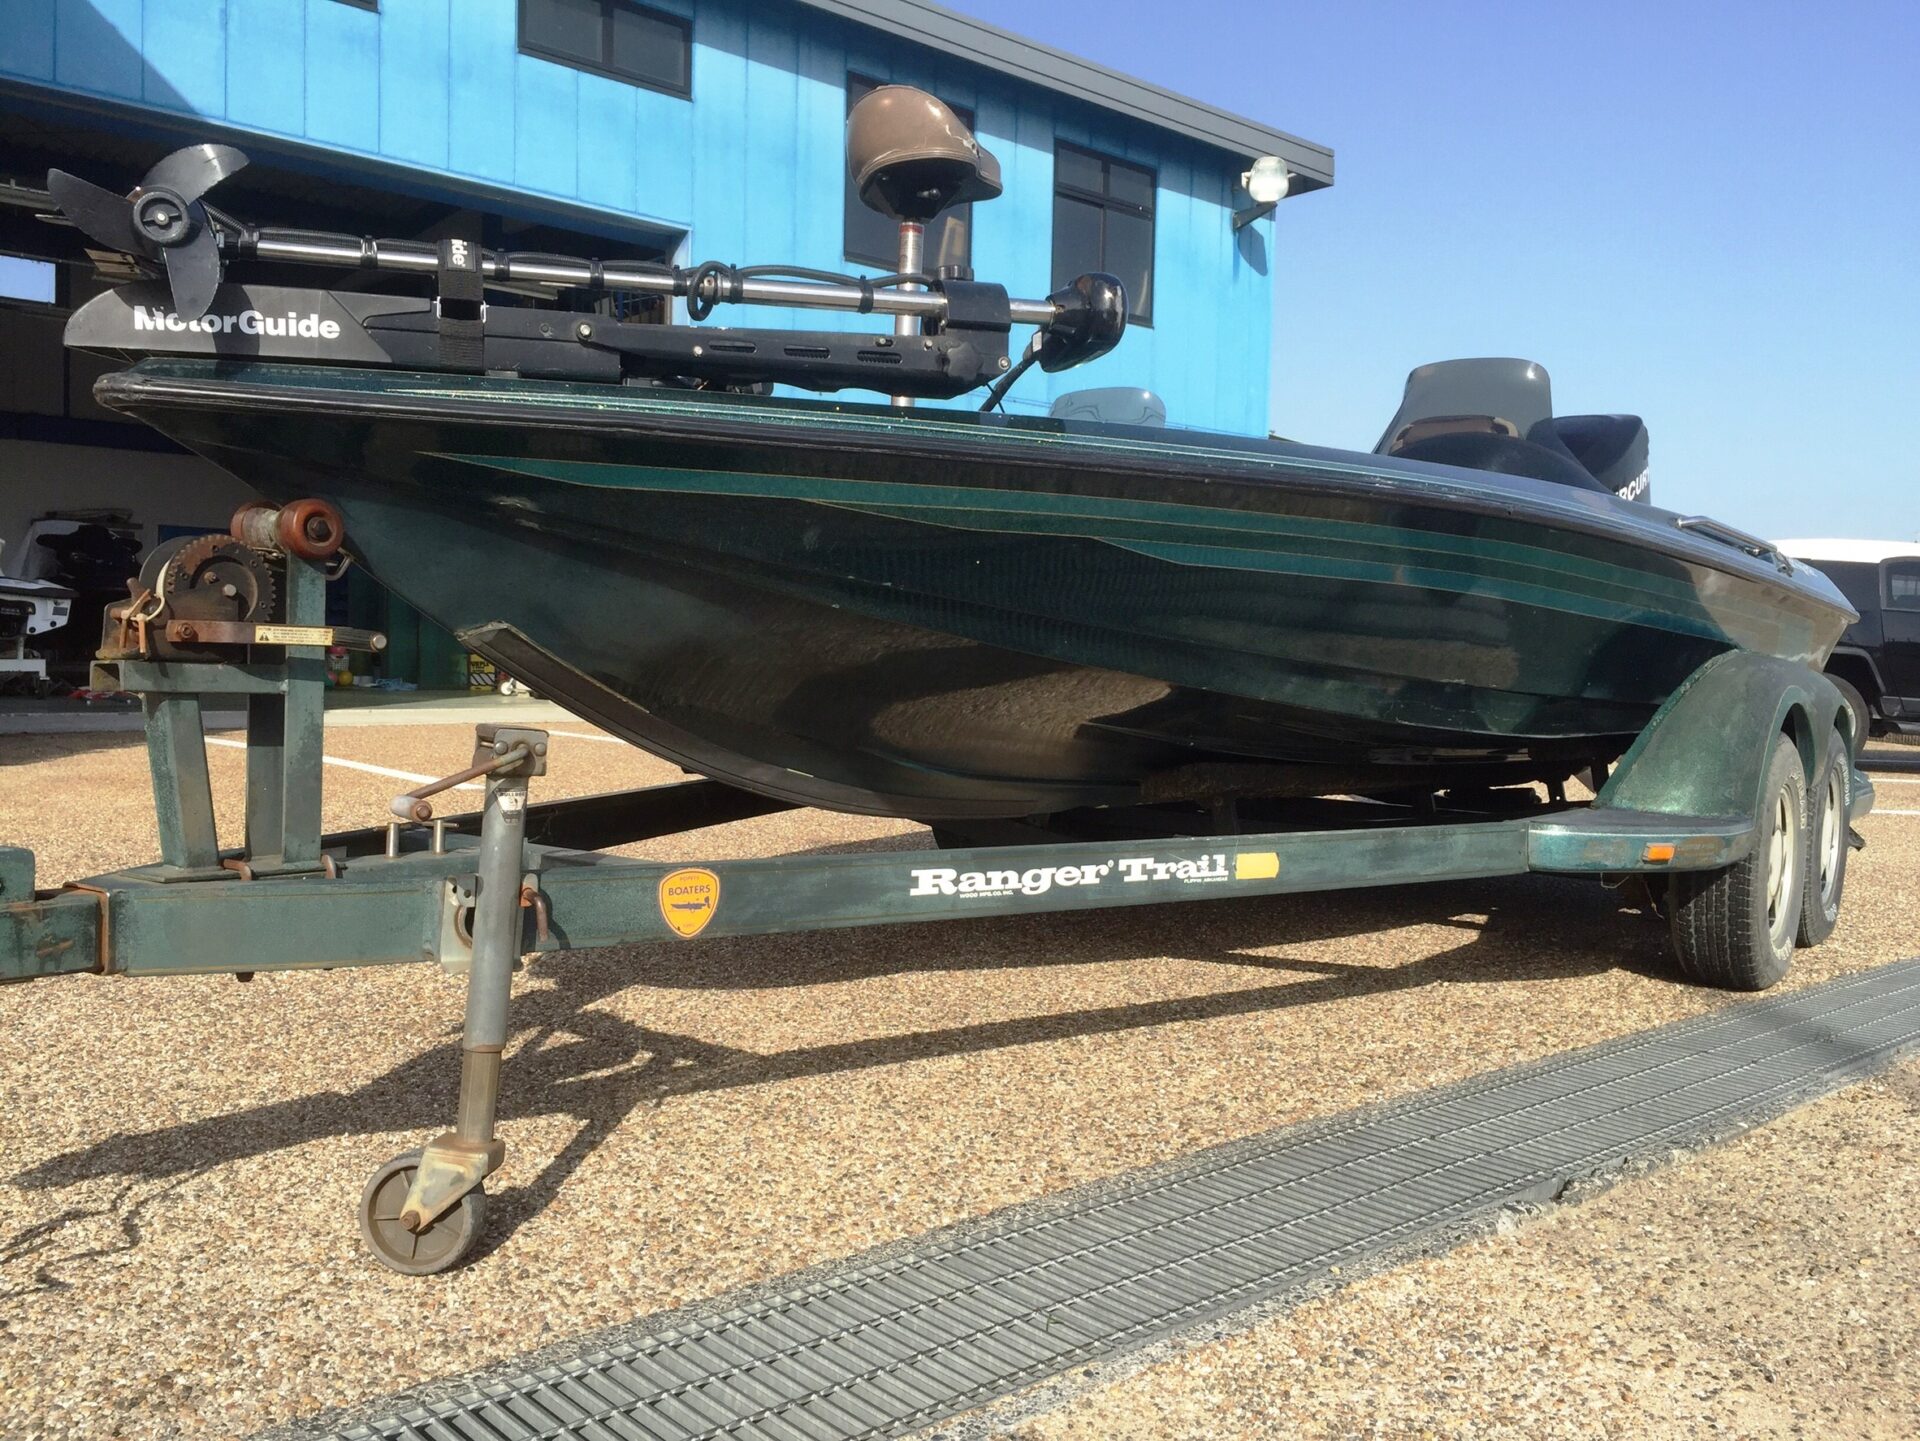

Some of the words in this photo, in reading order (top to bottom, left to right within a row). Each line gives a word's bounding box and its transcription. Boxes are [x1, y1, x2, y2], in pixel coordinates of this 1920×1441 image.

[910, 864, 1110, 896] Ranger
[1118, 854, 1229, 882] Trail
[668, 884, 711, 896] BOATERS
